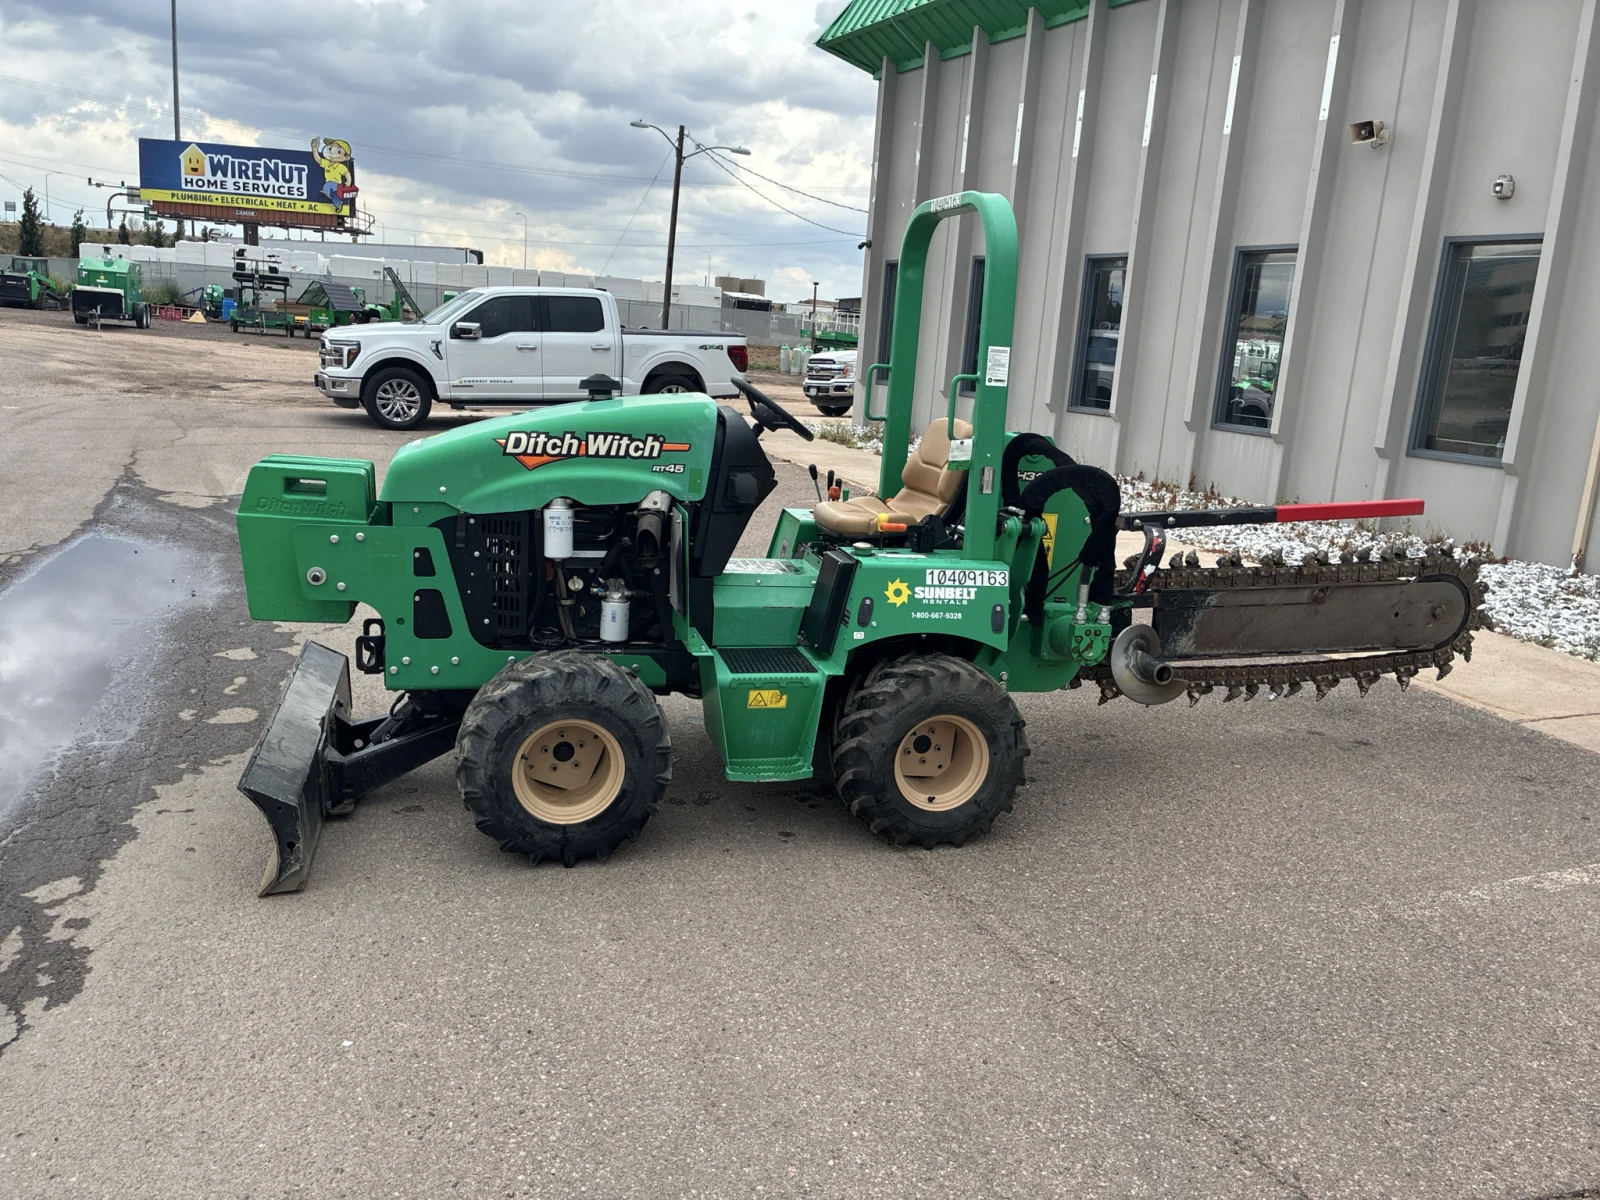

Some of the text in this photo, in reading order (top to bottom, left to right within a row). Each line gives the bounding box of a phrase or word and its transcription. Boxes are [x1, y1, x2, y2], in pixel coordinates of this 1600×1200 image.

[184, 177, 305, 197] HOME SERVICES
[170, 192, 214, 203] PLUMBING
[220, 196, 269, 207] ELECTRICAL
[276, 201, 297, 209] HEAT
[505, 432, 661, 457] Ditch Witch
[652, 464, 685, 473] RT45
[927, 570, 1007, 586] 10409163
[914, 586, 978, 600] SUNBELT
[911, 612, 962, 620] 1-800-667-9328
